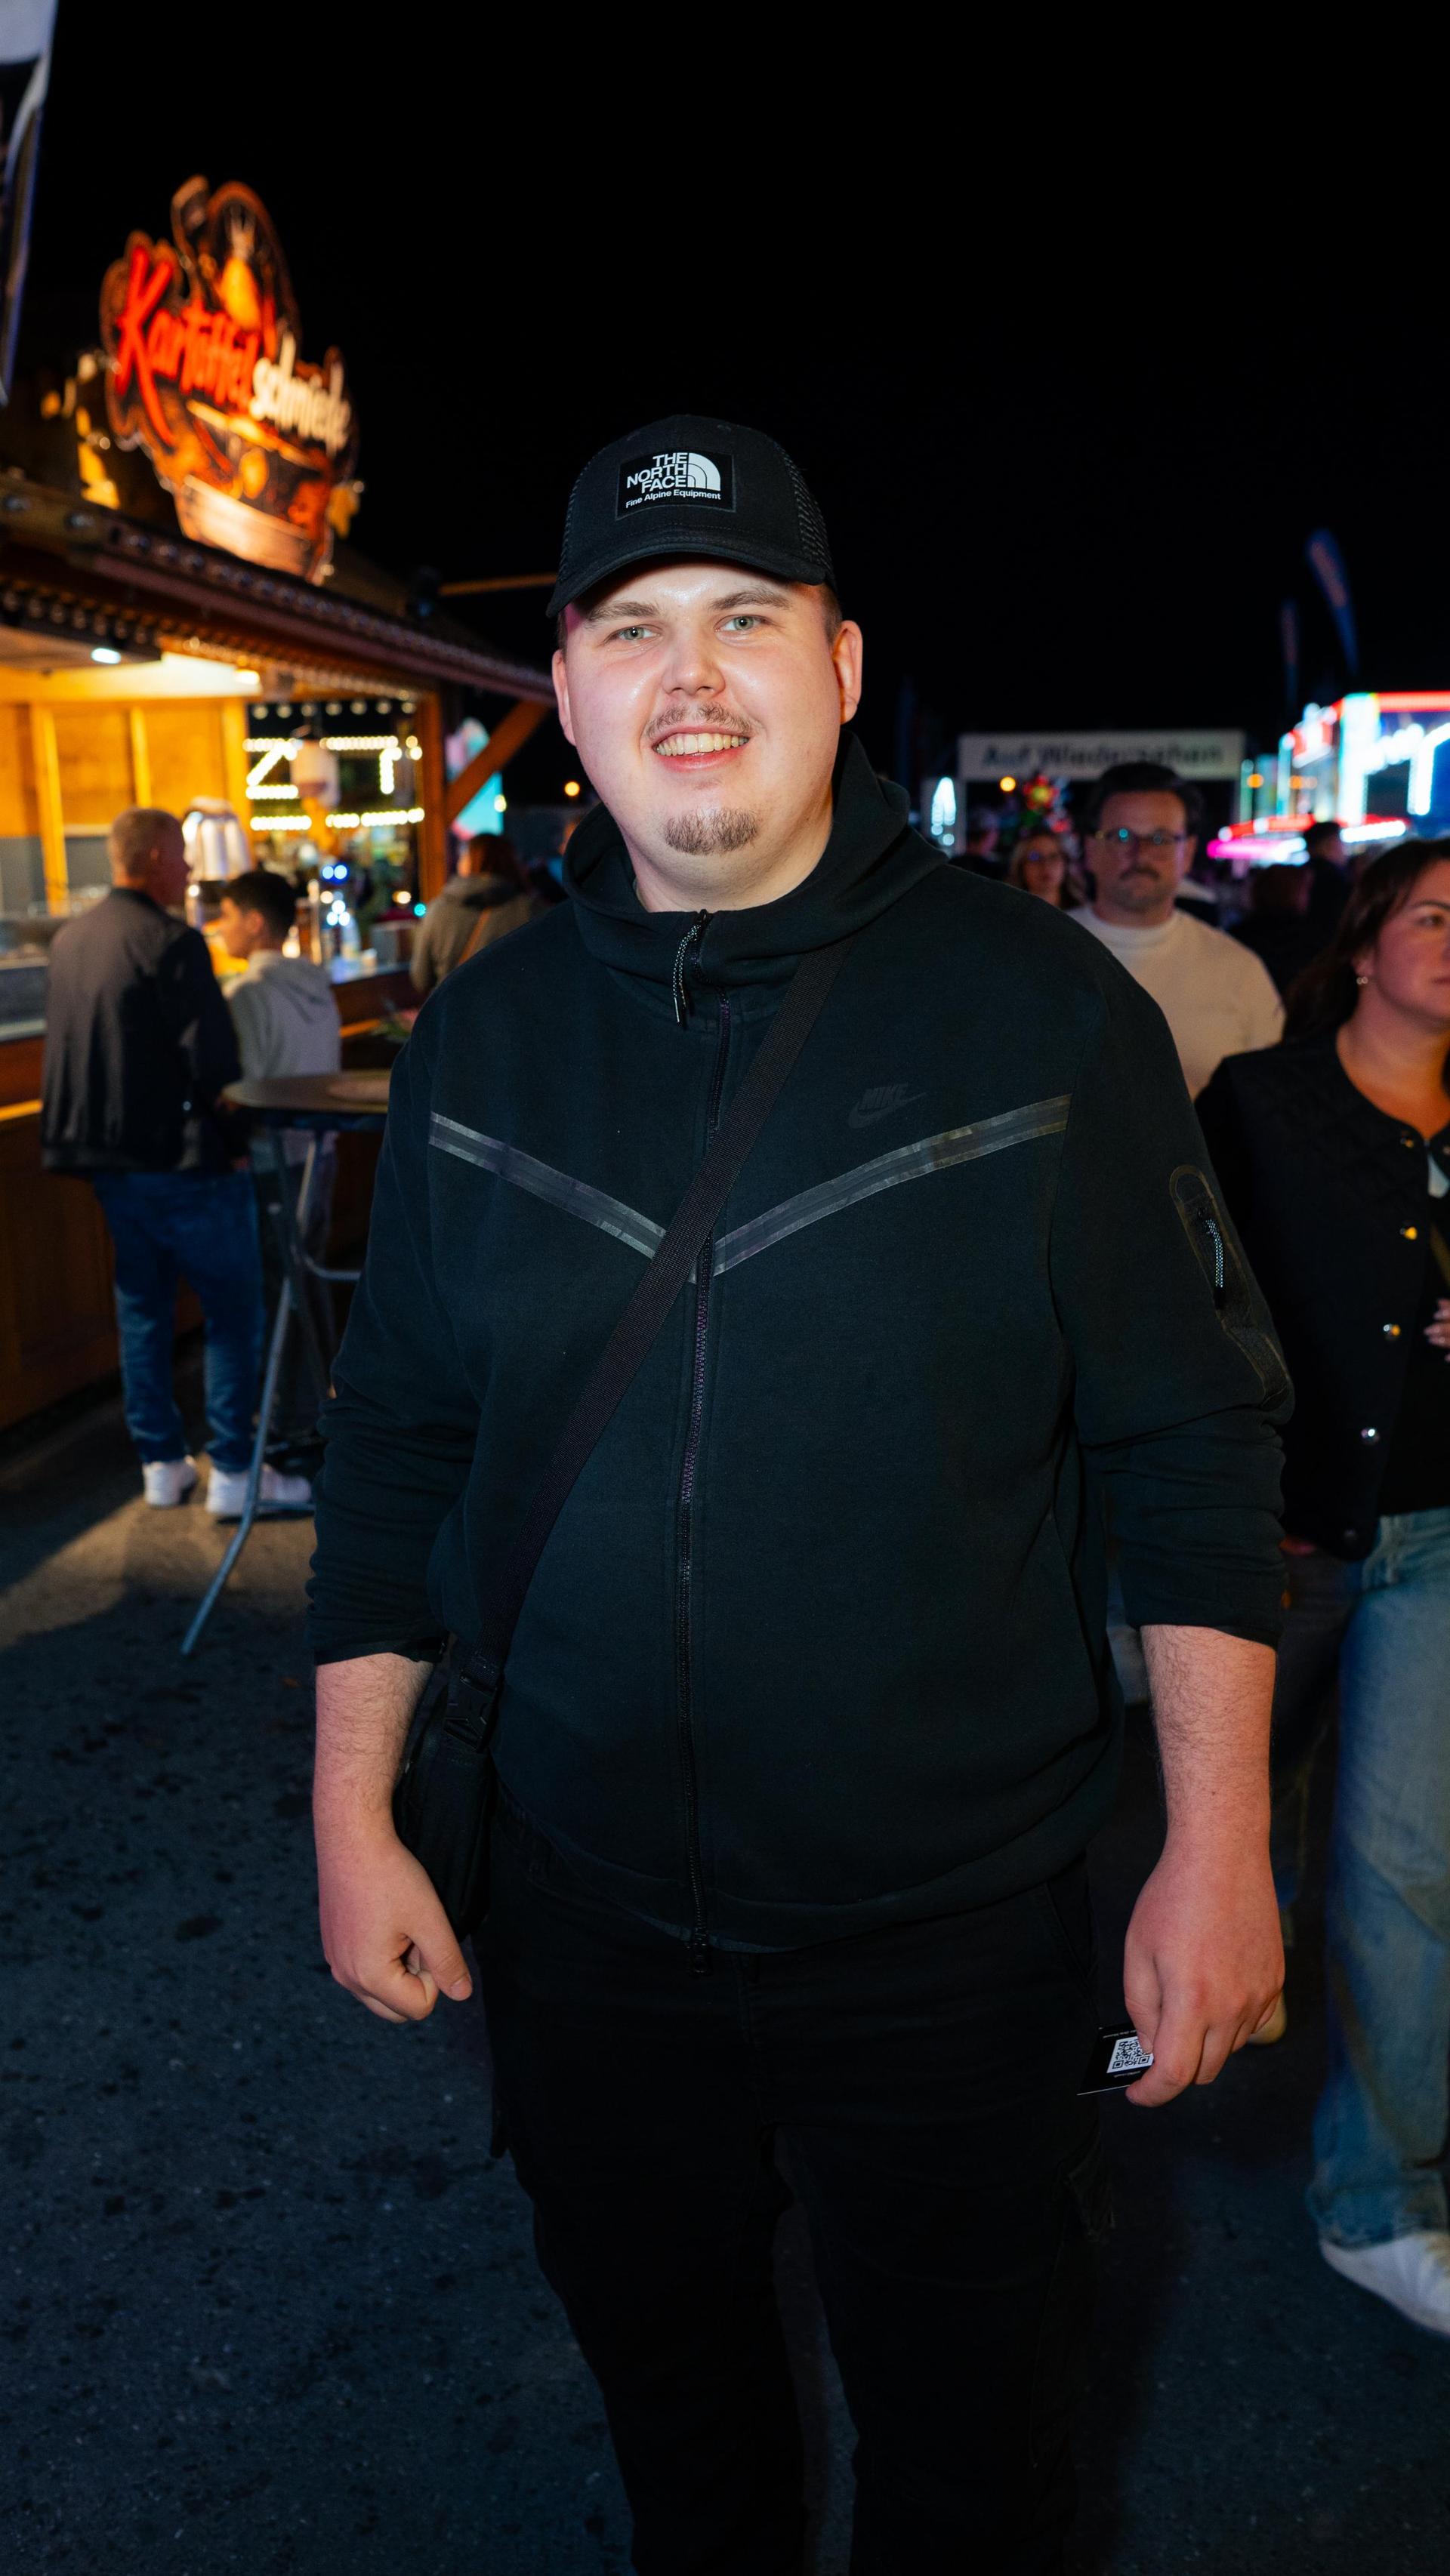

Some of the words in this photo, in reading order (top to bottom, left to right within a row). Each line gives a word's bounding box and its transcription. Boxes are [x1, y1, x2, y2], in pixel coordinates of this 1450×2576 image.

[652, 452, 688, 467] THE
[627, 464, 687, 488] NORTH
[641, 475, 686, 494] FACE
[625, 497, 643, 509] Fine
[643, 491, 672, 501] Alpine
[673, 488, 721, 500] Equipment
[983, 745, 1032, 766] Auf
[858, 1083, 909, 1110] NIKE
